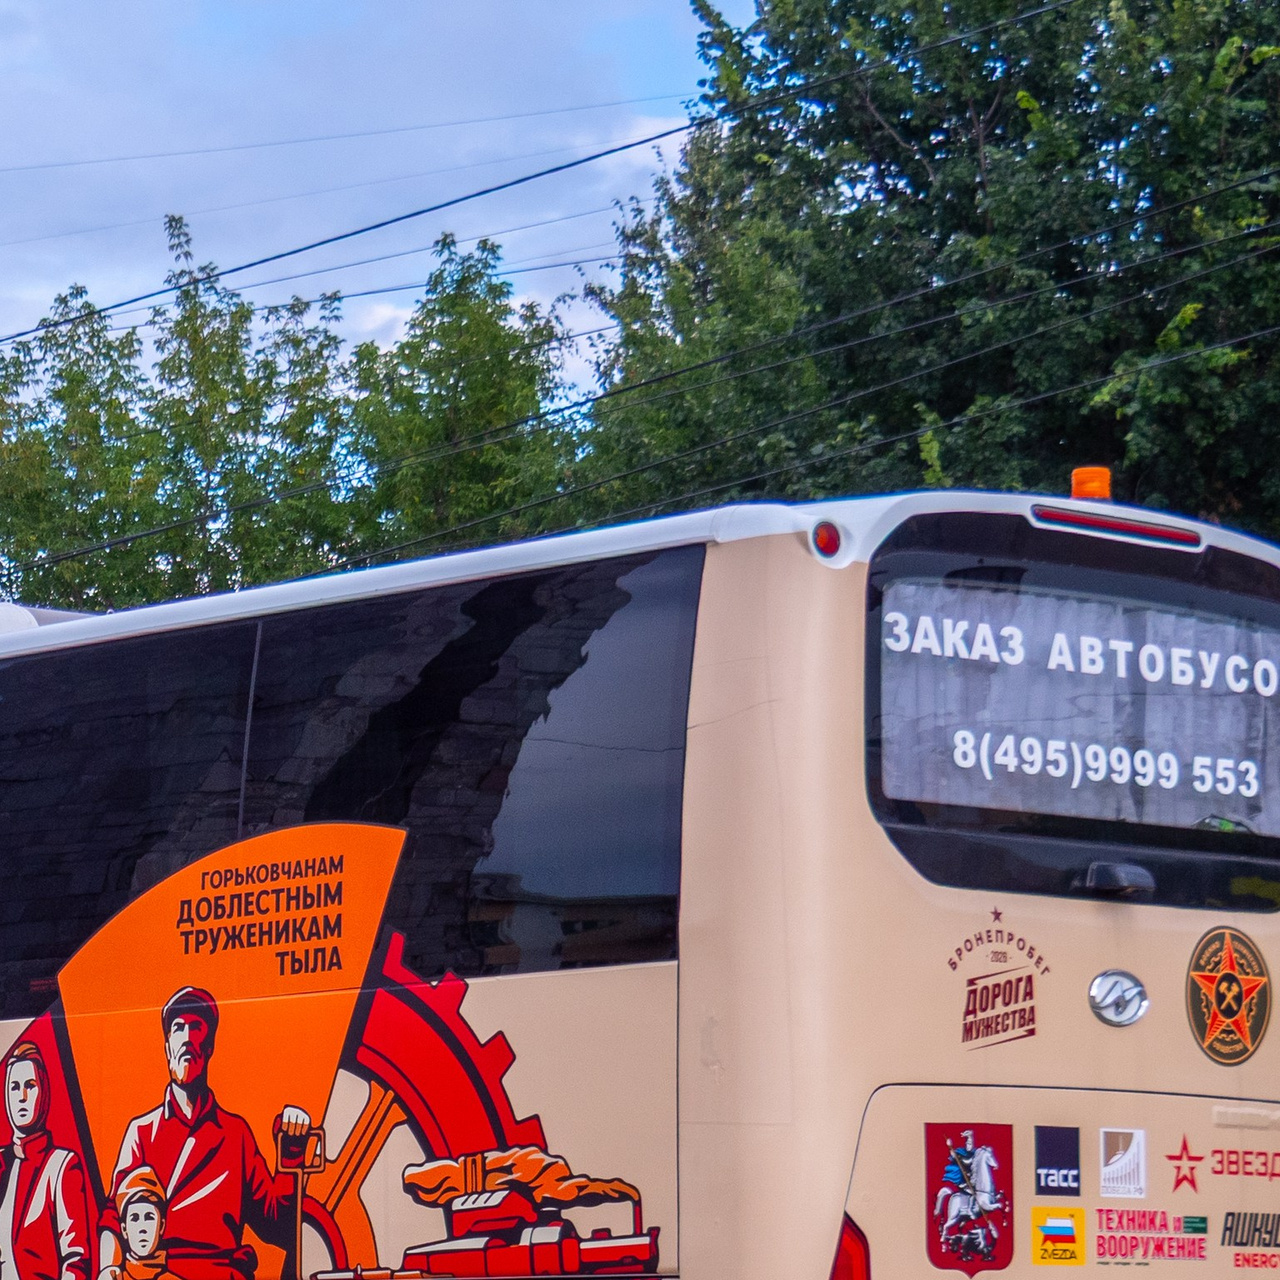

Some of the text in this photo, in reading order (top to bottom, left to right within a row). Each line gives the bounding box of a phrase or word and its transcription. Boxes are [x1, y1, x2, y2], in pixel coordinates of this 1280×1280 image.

[884, 612, 1279, 697] ЗАКАЗ АВТОБУСО
[953, 730, 1260, 797] 8(495)9999 553
[201, 855, 344, 890] ГОРЬКОВЧАНАМ
[176, 881, 343, 929] ДОБЛЕСТНЫМ
[180, 913, 342, 955] ТРУЖЕНИКАМ
[948, 930, 1051, 975] БРОНЕПРОБЕГ
[275, 946, 343, 976] ТЫЛА
[963, 974, 1034, 1022] ДОРОГА
[961, 1005, 1036, 1043] МУЖЕСТВА
[1096, 1208, 1169, 1232] ТЕХНИКА
[1040, 1248, 1077, 1260] ZVEZDA
[1096, 1235, 1207, 1260] ВООРУЖЕНИЕ
